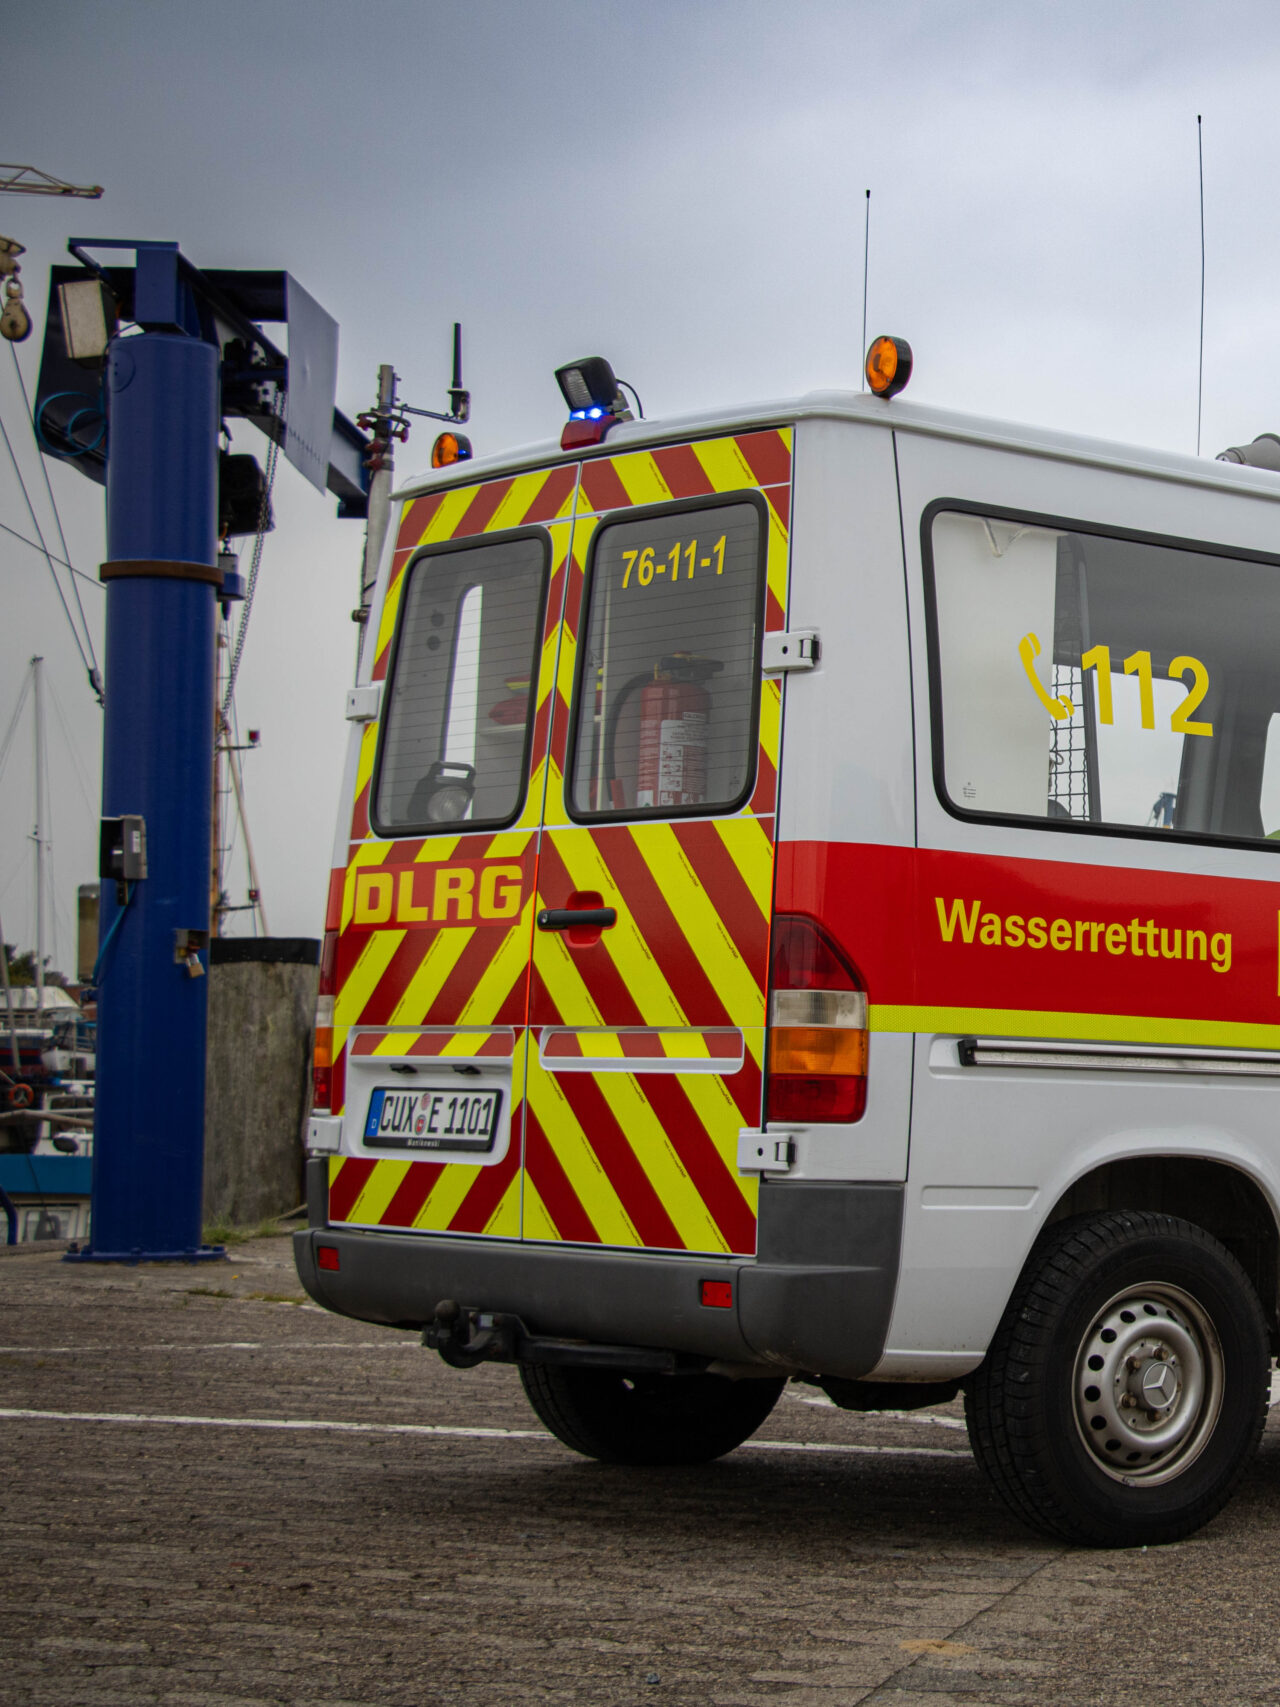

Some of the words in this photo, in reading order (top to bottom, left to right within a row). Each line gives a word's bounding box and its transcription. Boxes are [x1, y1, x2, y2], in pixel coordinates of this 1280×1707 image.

[622, 535, 726, 589] 76-11-1
[1081, 645, 1214, 737] 112
[353, 865, 523, 924] DLRG
[934, 897, 1233, 973] Wasserrettung
[380, 1096, 419, 1132] CUX
[427, 1096, 444, 1133] E
[444, 1097, 493, 1135] 1101
